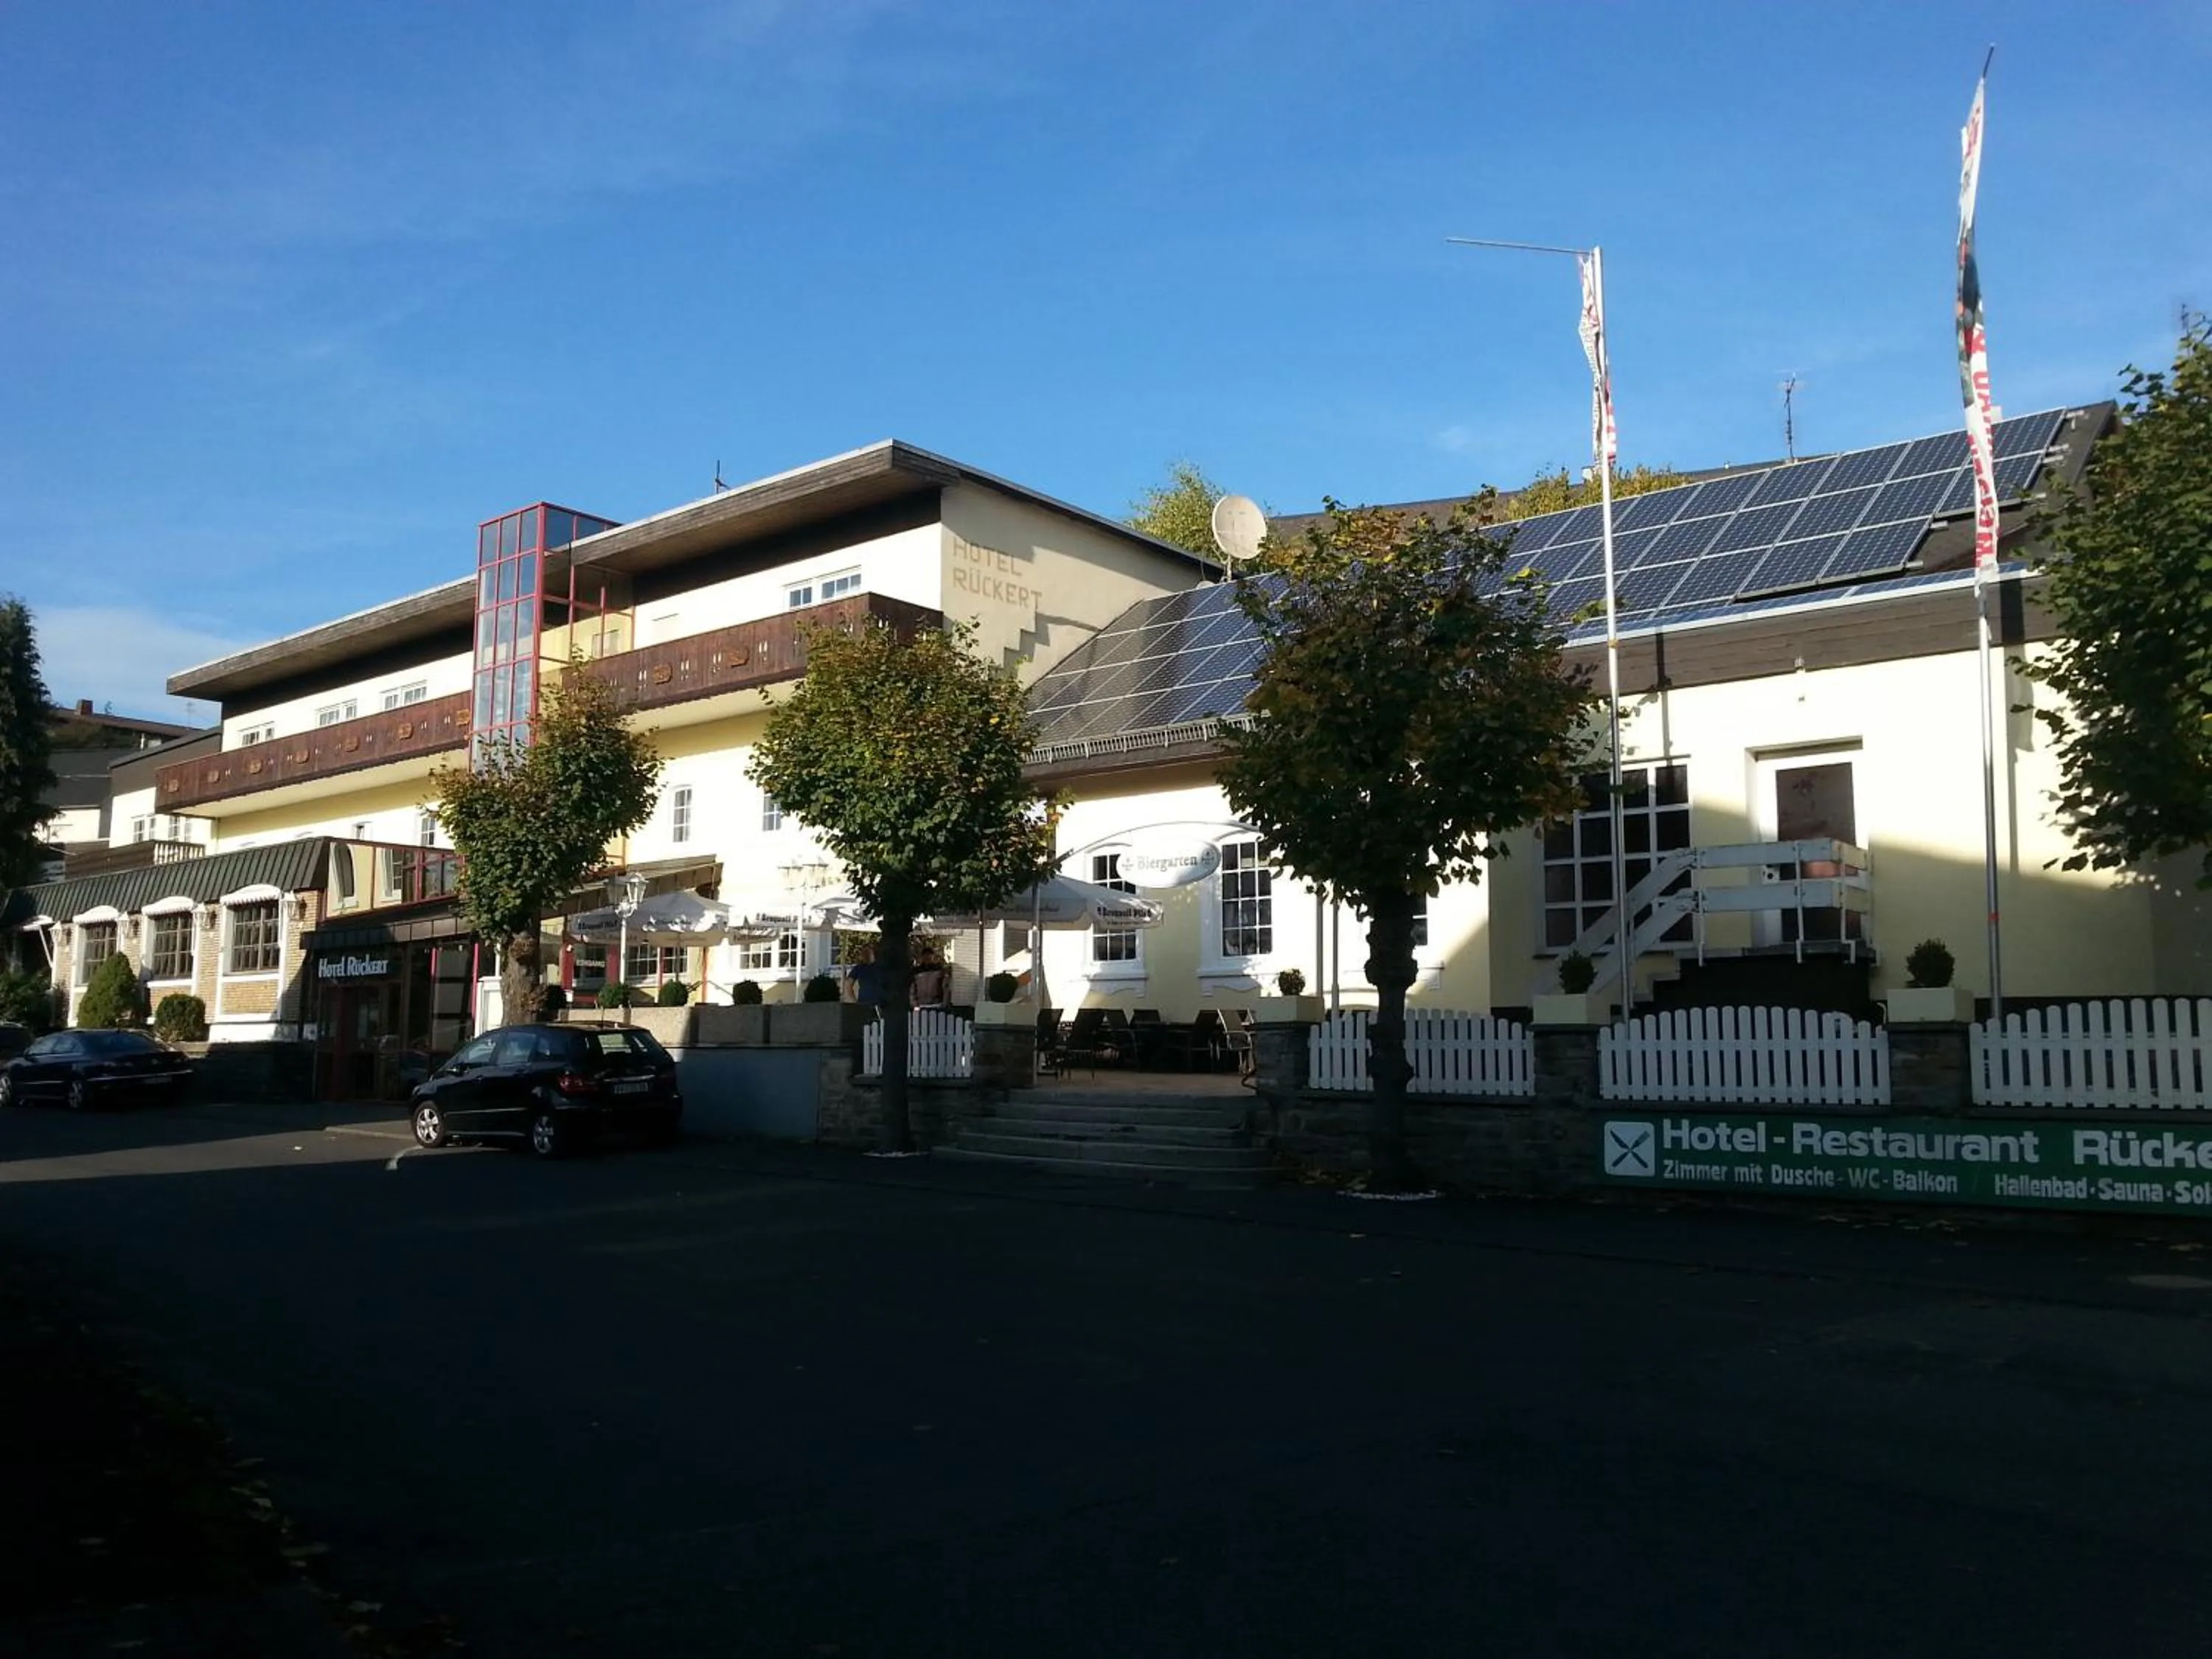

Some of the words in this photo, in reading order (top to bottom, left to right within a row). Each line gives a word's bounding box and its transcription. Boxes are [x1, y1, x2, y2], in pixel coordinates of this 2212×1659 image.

[953, 537, 1022, 577] HOTEL
[953, 566, 1043, 610] RÜCKERT
[1136, 855, 1197, 872] Biergarten
[1663, 1159, 1728, 1181] Zimmer
[1734, 1163, 1764, 1184] mit
